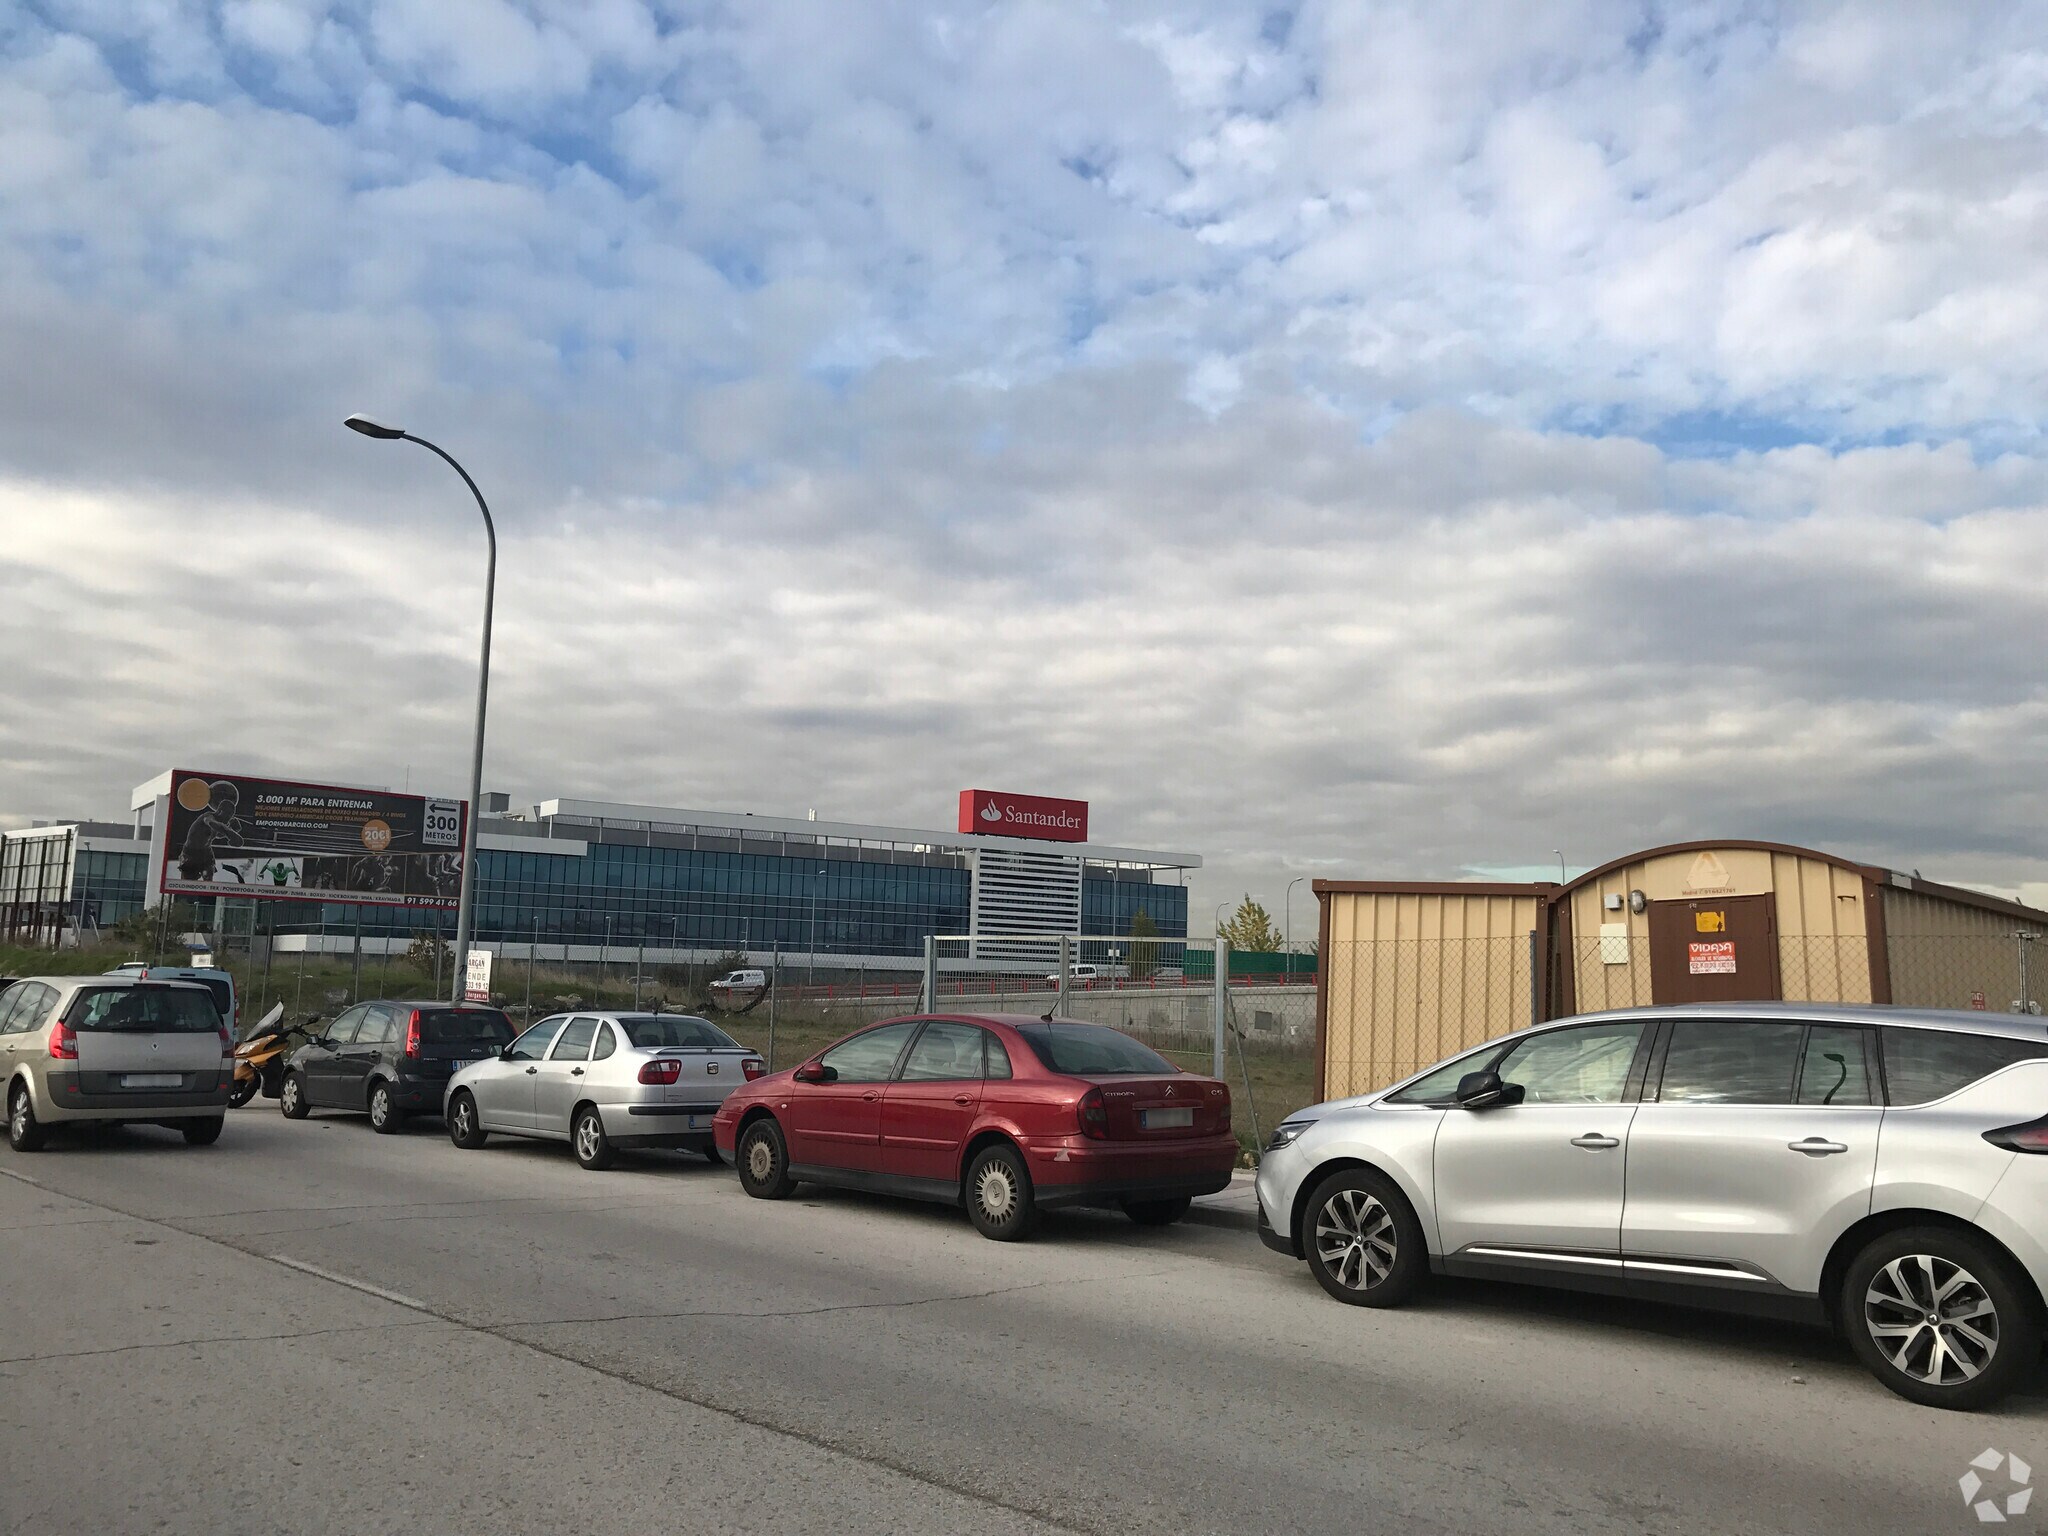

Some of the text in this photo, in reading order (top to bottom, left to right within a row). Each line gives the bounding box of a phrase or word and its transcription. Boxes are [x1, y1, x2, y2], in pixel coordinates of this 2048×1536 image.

[256, 794, 284, 804] 3.000
[300, 797, 325, 807] PARA
[327, 799, 373, 809] ENTRENAR
[1005, 805, 1081, 829] Santander
[426, 815, 457, 831] 300
[425, 831, 457, 841] METROS
[419, 898, 434, 906] 599
[468, 958, 485, 969] ARGAN
[467, 972, 487, 981] ENDE
